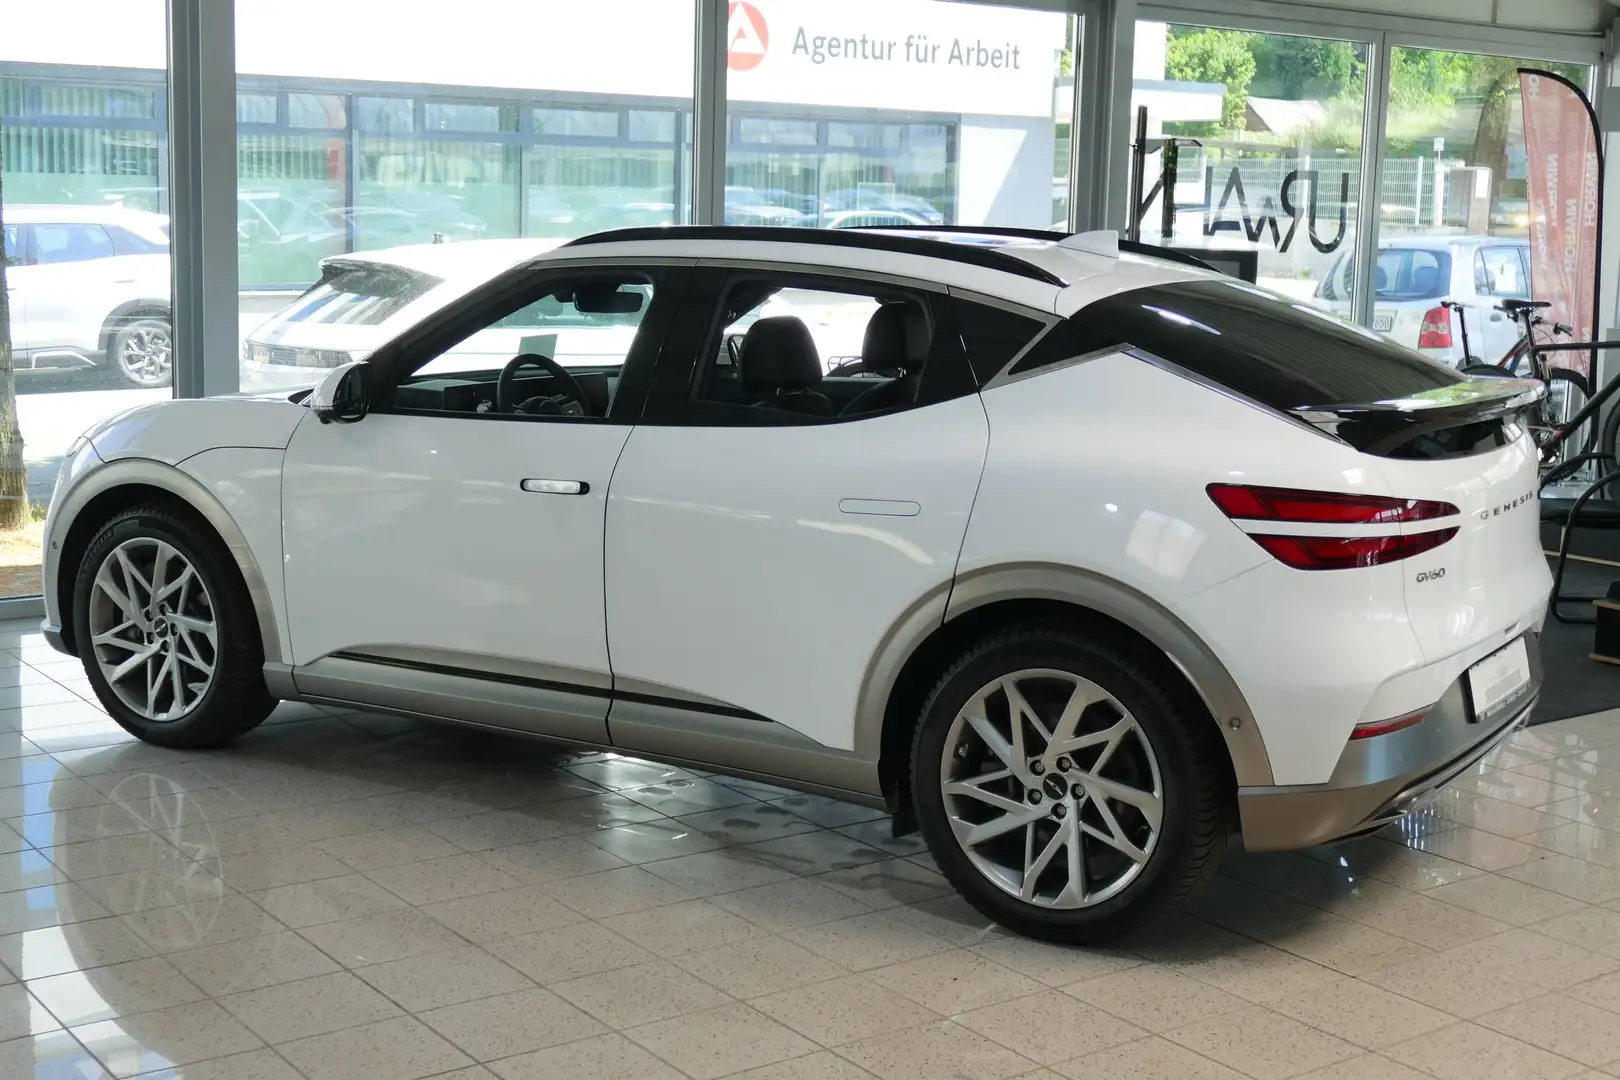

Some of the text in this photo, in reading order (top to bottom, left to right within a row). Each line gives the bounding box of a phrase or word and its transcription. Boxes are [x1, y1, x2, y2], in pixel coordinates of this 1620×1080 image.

[792, 26, 1021, 70] Agentur für Arbeit
[1480, 490, 1534, 521] GENESIS
[1416, 567, 1446, 584] GV60
